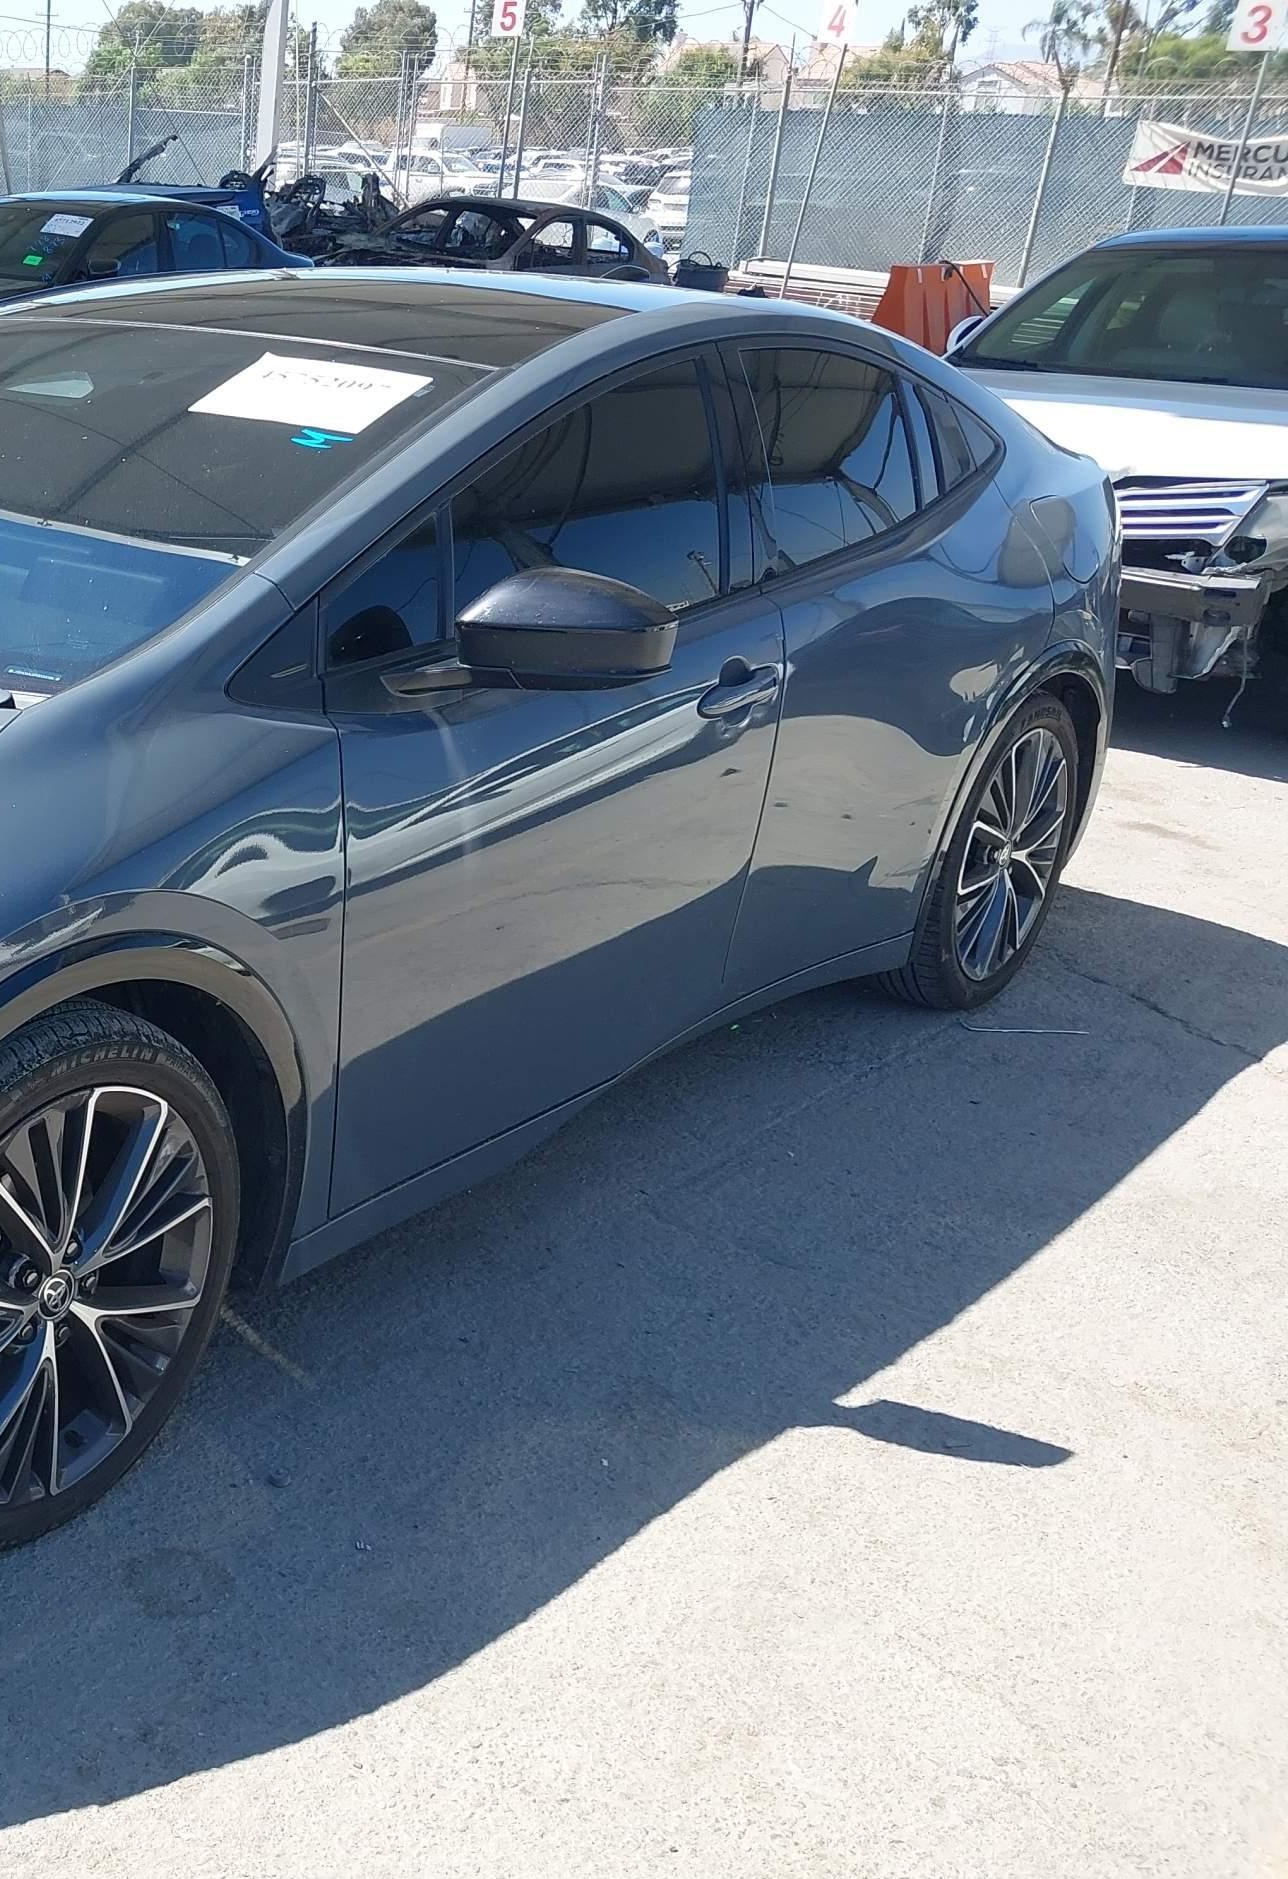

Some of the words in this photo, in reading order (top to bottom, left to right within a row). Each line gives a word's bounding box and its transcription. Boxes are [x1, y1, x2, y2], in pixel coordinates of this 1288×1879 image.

[499, 1, 517, 31] 5
[827, 4, 847, 38] 4
[1240, 5, 1272, 44] 3
[50, 1045, 154, 1078] MICHELIN
